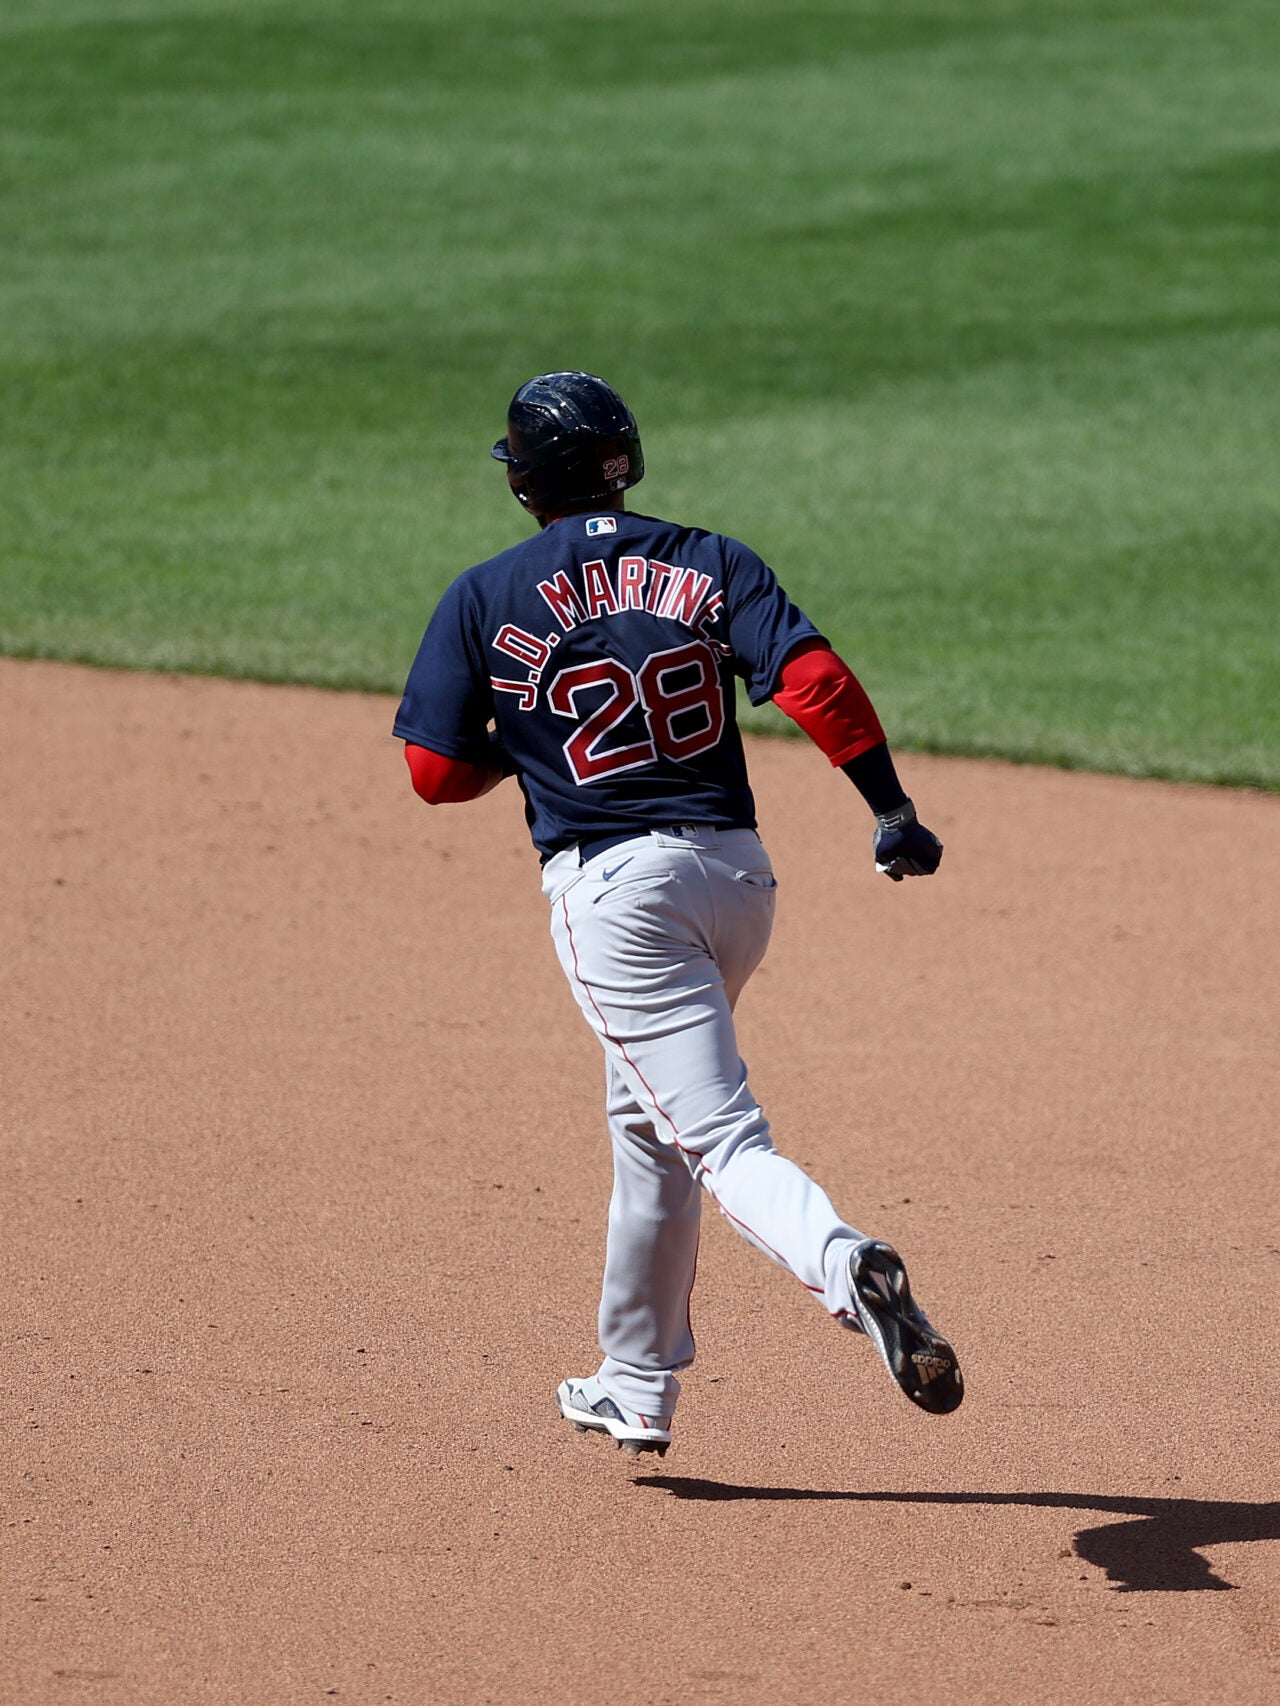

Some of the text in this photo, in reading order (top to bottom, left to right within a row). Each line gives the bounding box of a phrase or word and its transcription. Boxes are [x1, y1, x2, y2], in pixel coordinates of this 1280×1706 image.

[603, 455, 629, 480] 28
[490, 623, 561, 711] J.D.
[546, 640, 725, 786] 28
[911, 1353, 951, 1369] adidas
